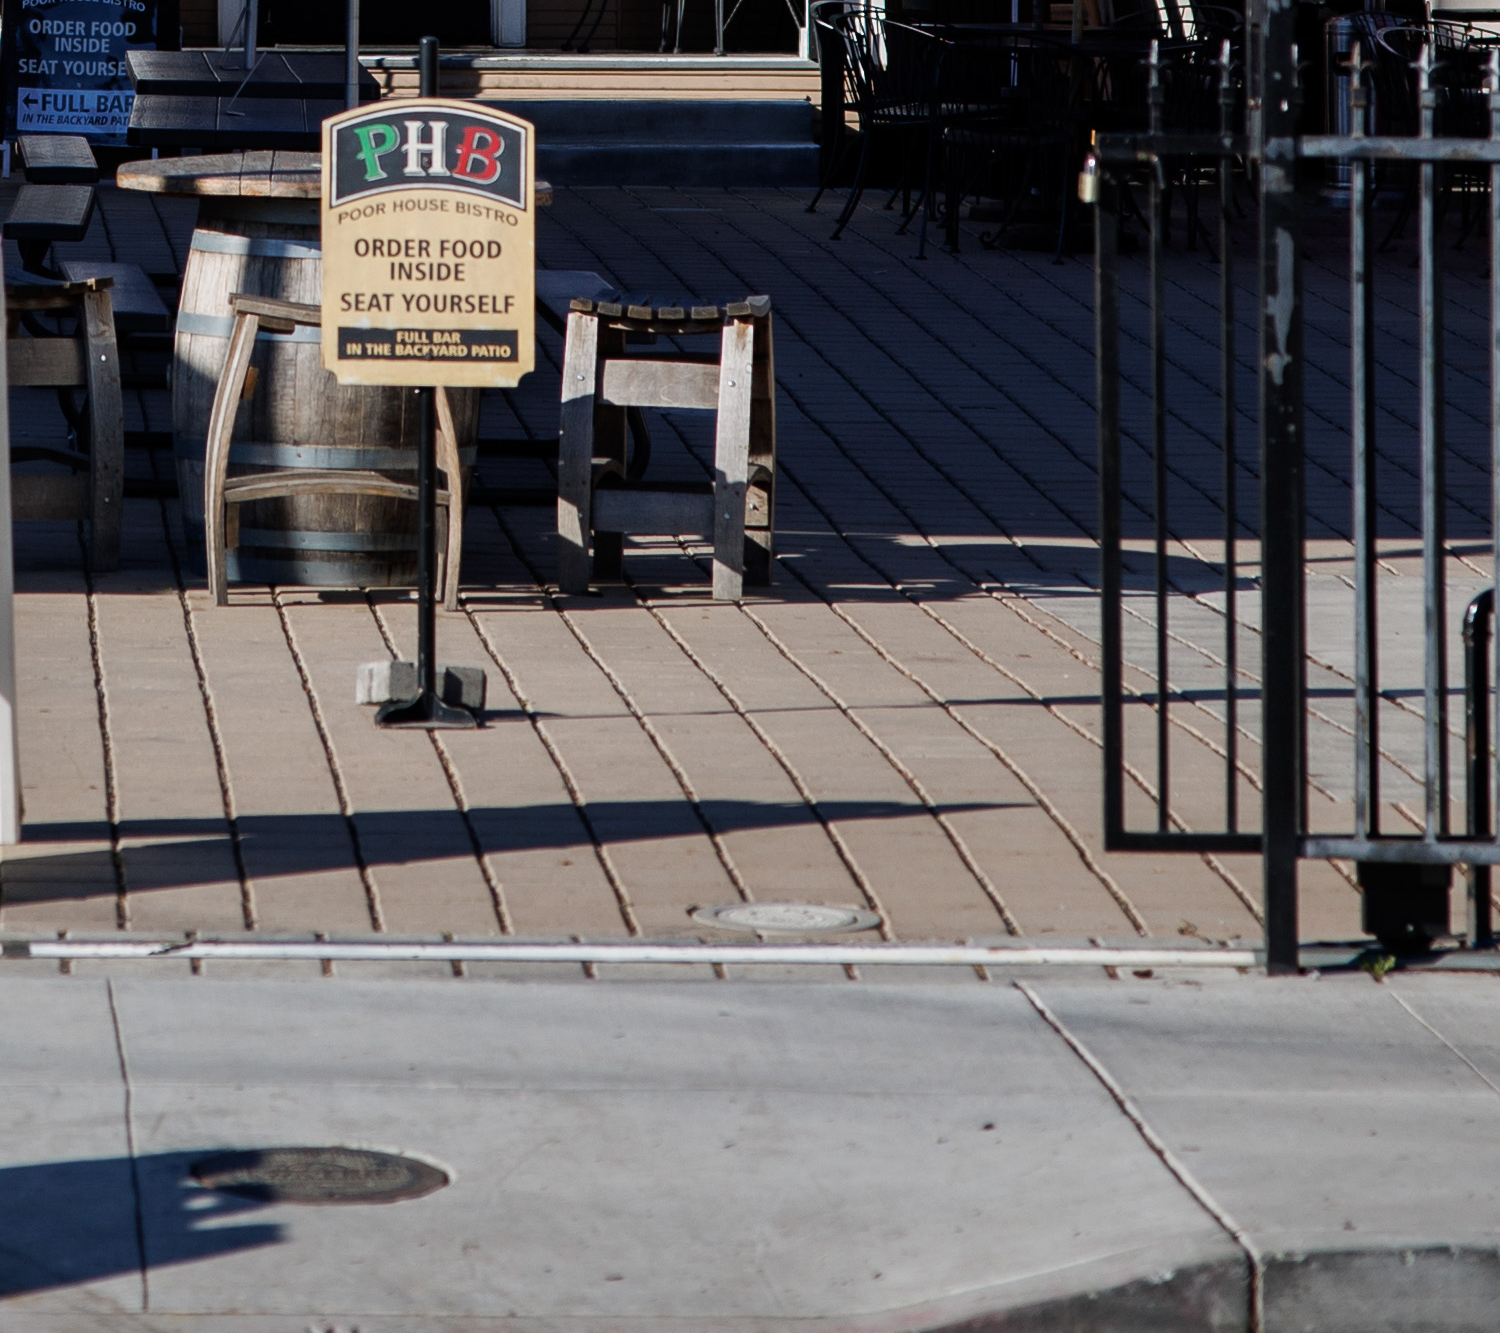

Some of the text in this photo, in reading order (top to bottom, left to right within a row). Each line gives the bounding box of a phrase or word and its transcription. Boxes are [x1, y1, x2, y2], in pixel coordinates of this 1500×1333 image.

[29, 19, 137, 37] ORDER FOOD
[54, 37, 110, 53] INSIDE
[18, 59, 126, 76] SEAT YOURSE
[42, 94, 90, 112] FULL
[22, 114, 129, 126] IN THE BACKYARD PAT
[353, 120, 505, 184] PHB
[338, 199, 518, 226] POOR HOUSE BISTRO
[354, 239, 502, 258] ORDER FOOD
[390, 262, 465, 281] INSIDE
[340, 293, 515, 313] SEAT YOURSELF
[396, 331, 461, 344] FULL BAR
[346, 344, 511, 357] IN THE BACKYARD PATIO
